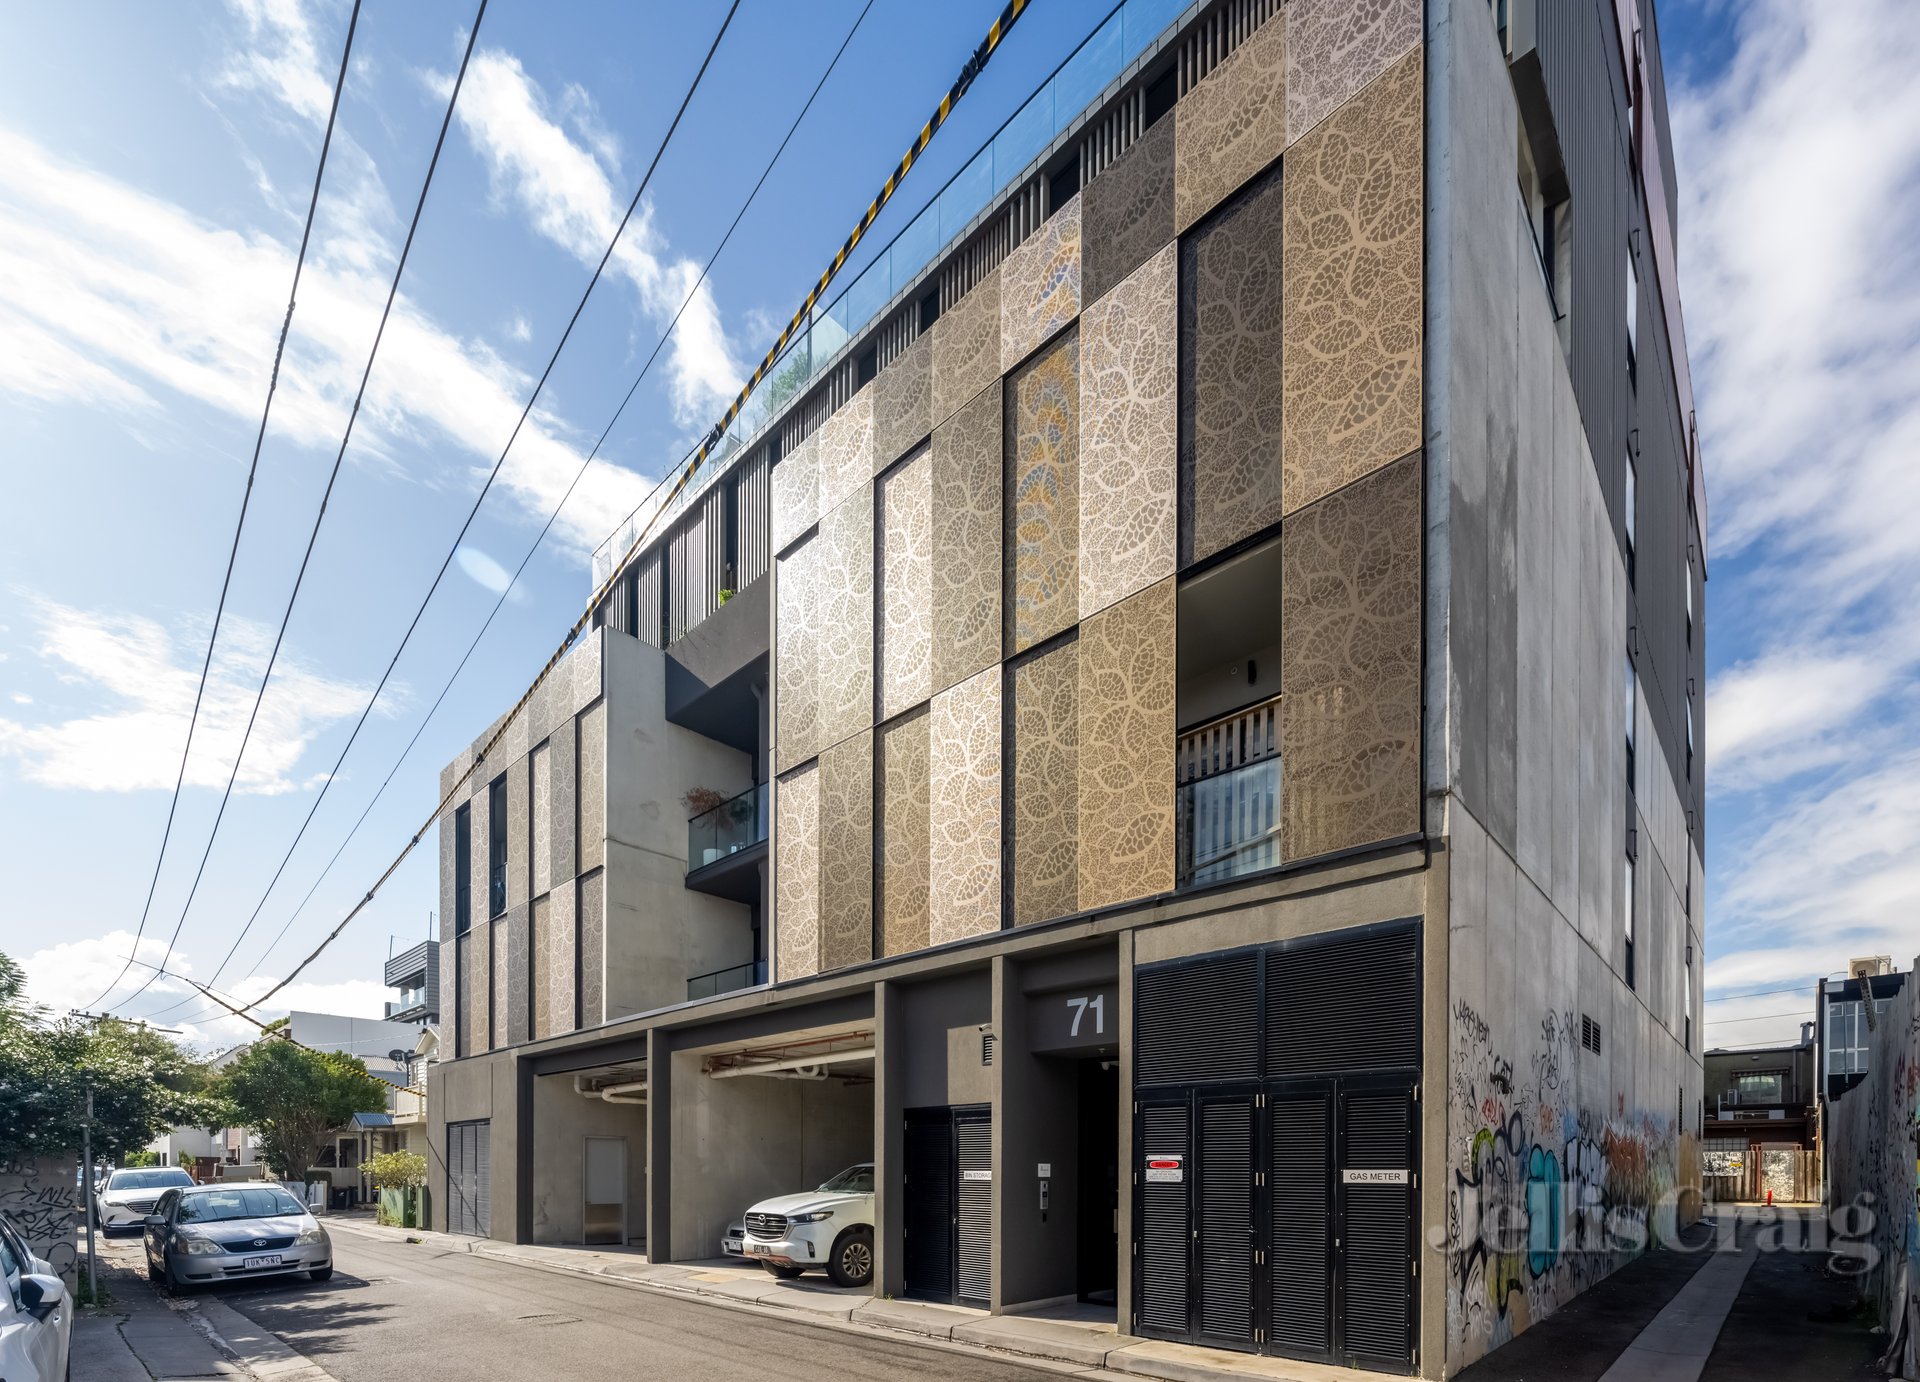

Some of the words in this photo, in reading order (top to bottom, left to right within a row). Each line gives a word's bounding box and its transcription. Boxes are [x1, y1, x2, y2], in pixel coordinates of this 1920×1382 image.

[1066, 994, 1104, 1037] 71
[1349, 1172, 1368, 1181] GAS
[1369, 1172, 1401, 1181] METER
